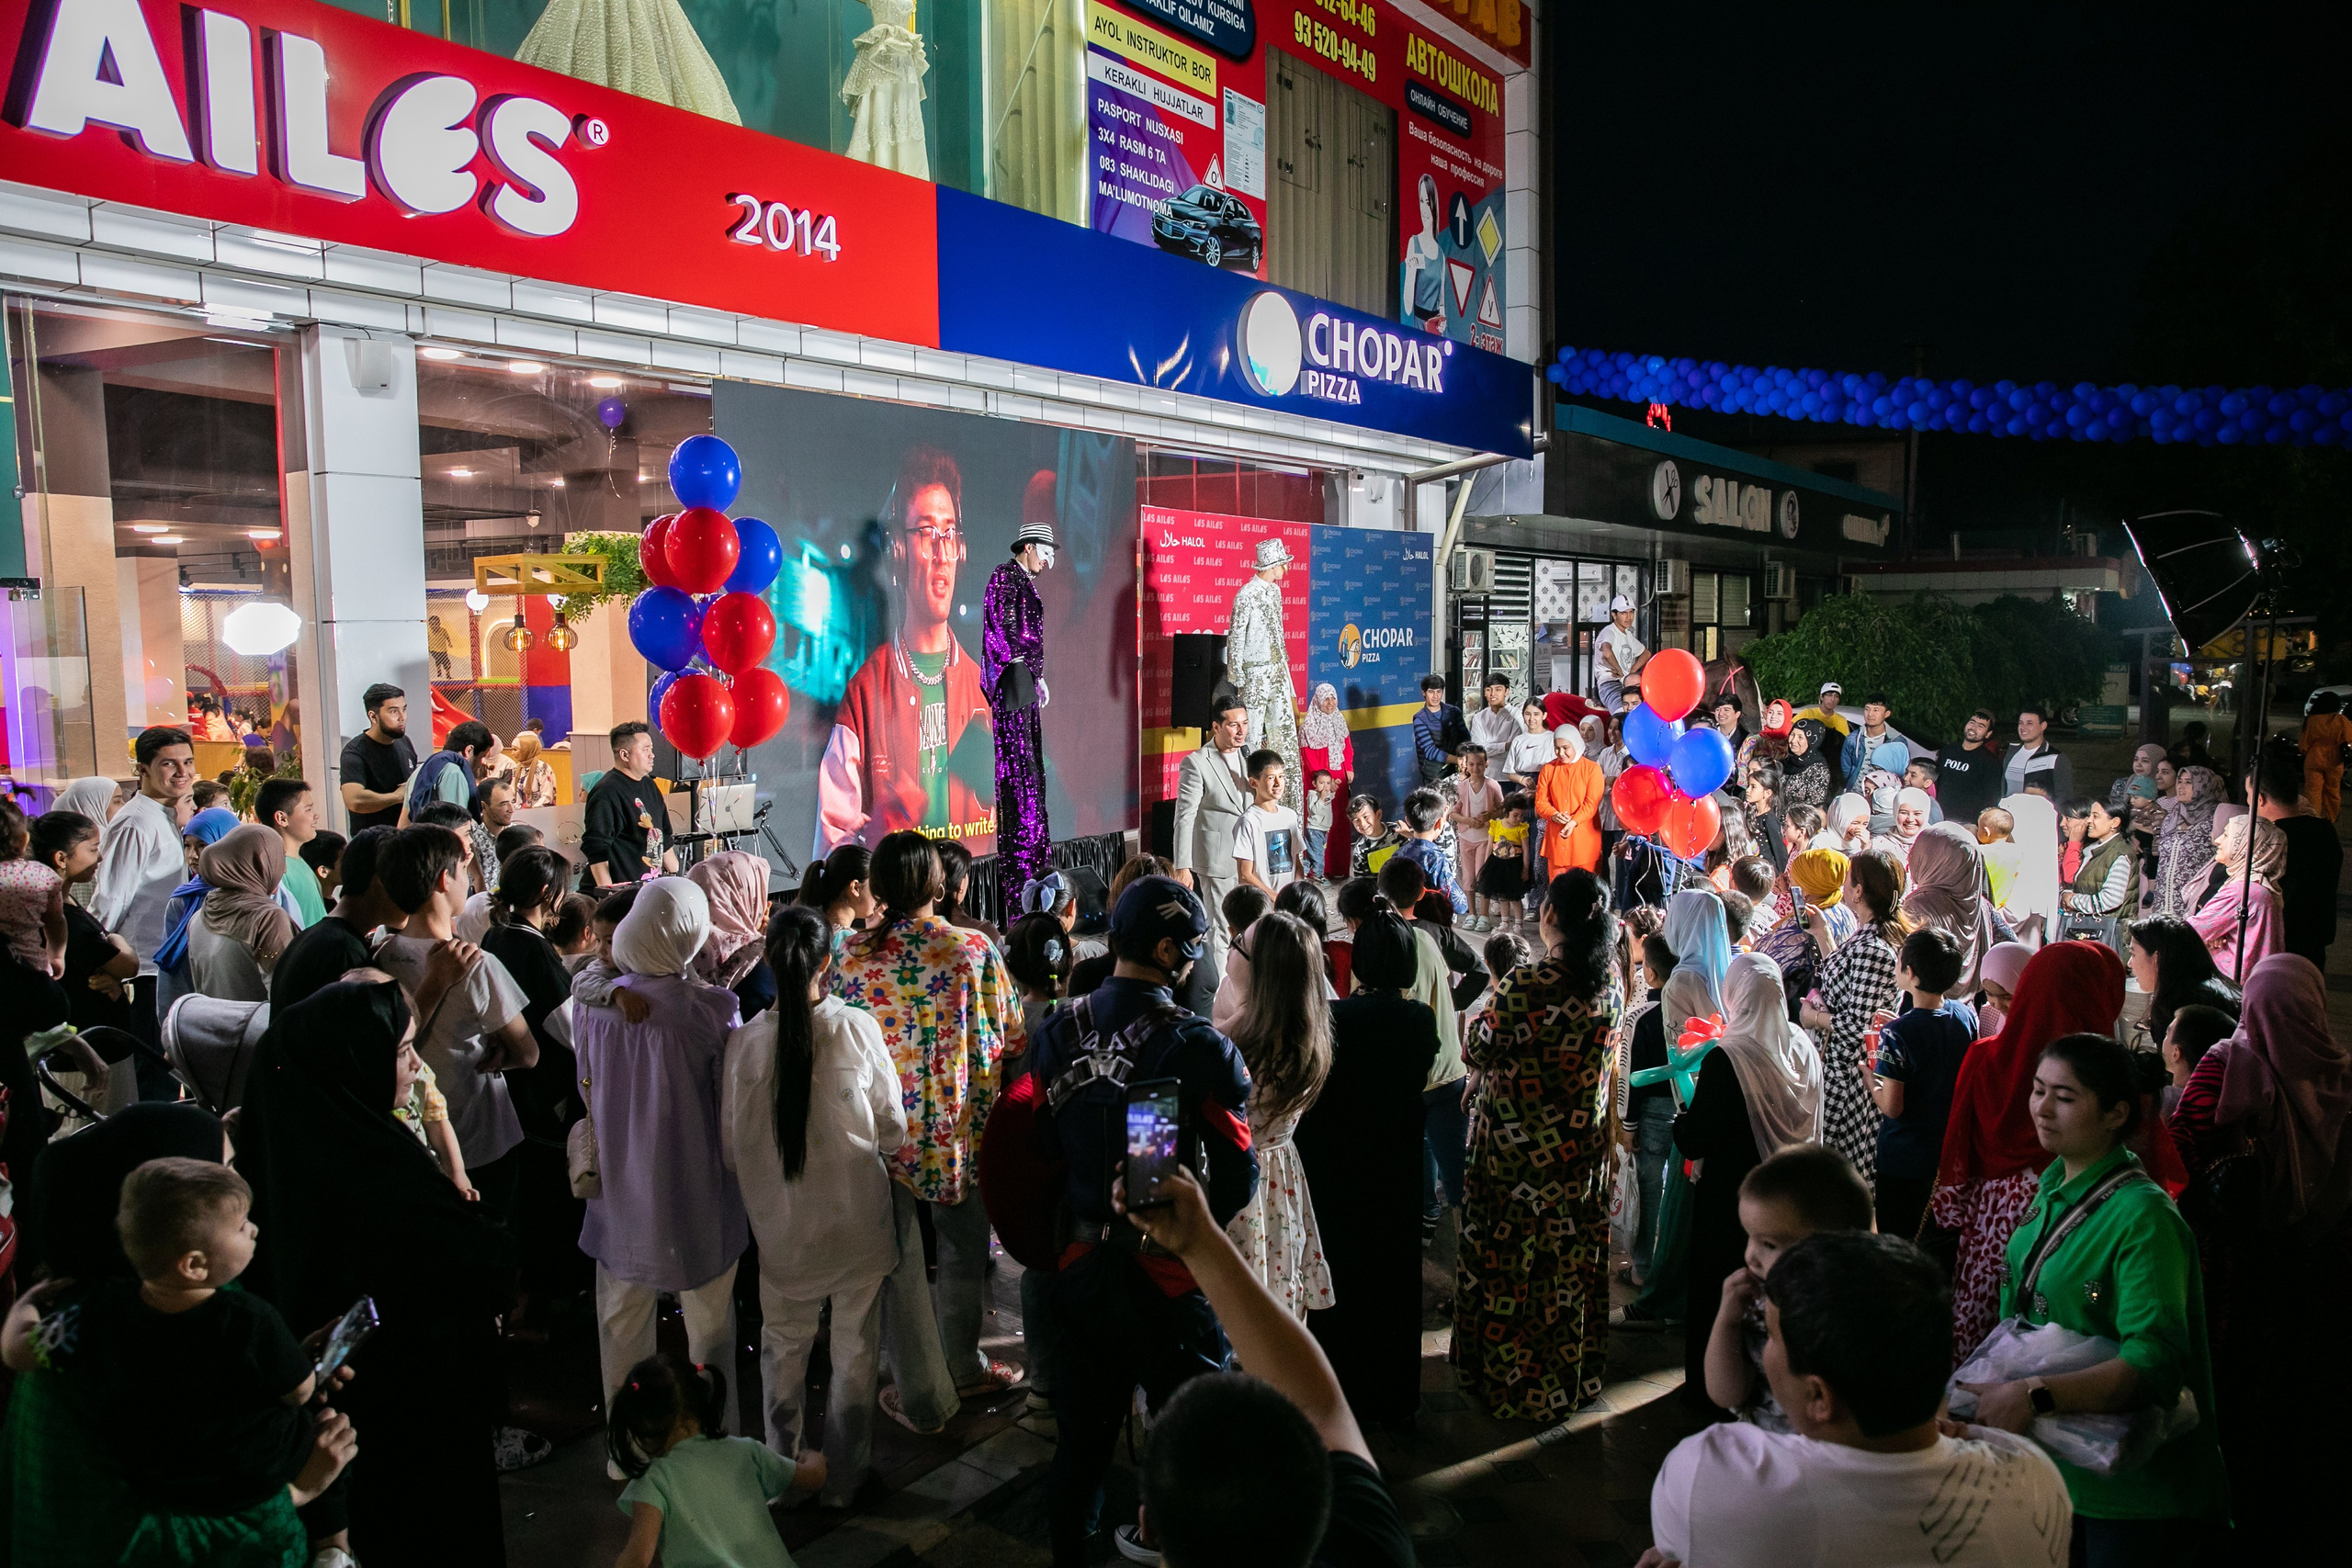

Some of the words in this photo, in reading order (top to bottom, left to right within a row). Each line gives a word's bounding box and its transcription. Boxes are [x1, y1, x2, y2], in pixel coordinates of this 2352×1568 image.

[1145, 0, 1176, 16] AKLIF
[1178, 5, 1215, 36] QILAMIZ
[1207, 0, 1247, 32] KURSIGA
[1094, 16, 1122, 41] AYOL
[1126, 29, 1187, 73] INSTRUKTOR
[1192, 61, 1212, 84] BOR
[1294, 10, 1312, 48] 93
[1314, 20, 1376, 83] 520-94-49
[1105, 65, 1147, 96] KERAKLI
[1153, 86, 1204, 120] HUJJATLAR
[1406, 32, 1499, 118] АВТОШКОЛА
[1098, 97, 1141, 128] PASPORT
[1146, 118, 1184, 145] NUSXASI
[1410, 89, 1436, 113] ОНЛАЙН
[1437, 104, 1468, 130] ОБУЧЕНИЕ
[1098, 127, 1115, 146] 3X4
[1119, 134, 1147, 158] RASM
[1148, 148, 1153, 160] 6
[1155, 149, 1167, 165] TA
[1408, 120, 1428, 143] Ваша
[1428, 131, 1472, 164] безопасность
[1474, 158, 1482, 169] на
[1482, 162, 1503, 180] дороге
[1099, 154, 1115, 174] 083
[1119, 162, 1175, 195] SHAKLIDAGI
[1430, 153, 1448, 171] наша
[1450, 164, 1485, 188] профессия
[733, 193, 842, 263] 2014
[1306, 311, 1443, 394] CHOPAR
[1307, 369, 1362, 404] PIZZA
[1182, 536, 1205, 547] HALOL
[1362, 653, 1381, 662] PIZZA
[1363, 627, 1413, 649] CHOPAR
[1944, 758, 1970, 772] POLO
[948, 821, 961, 839] to
[965, 818, 995, 838] write
